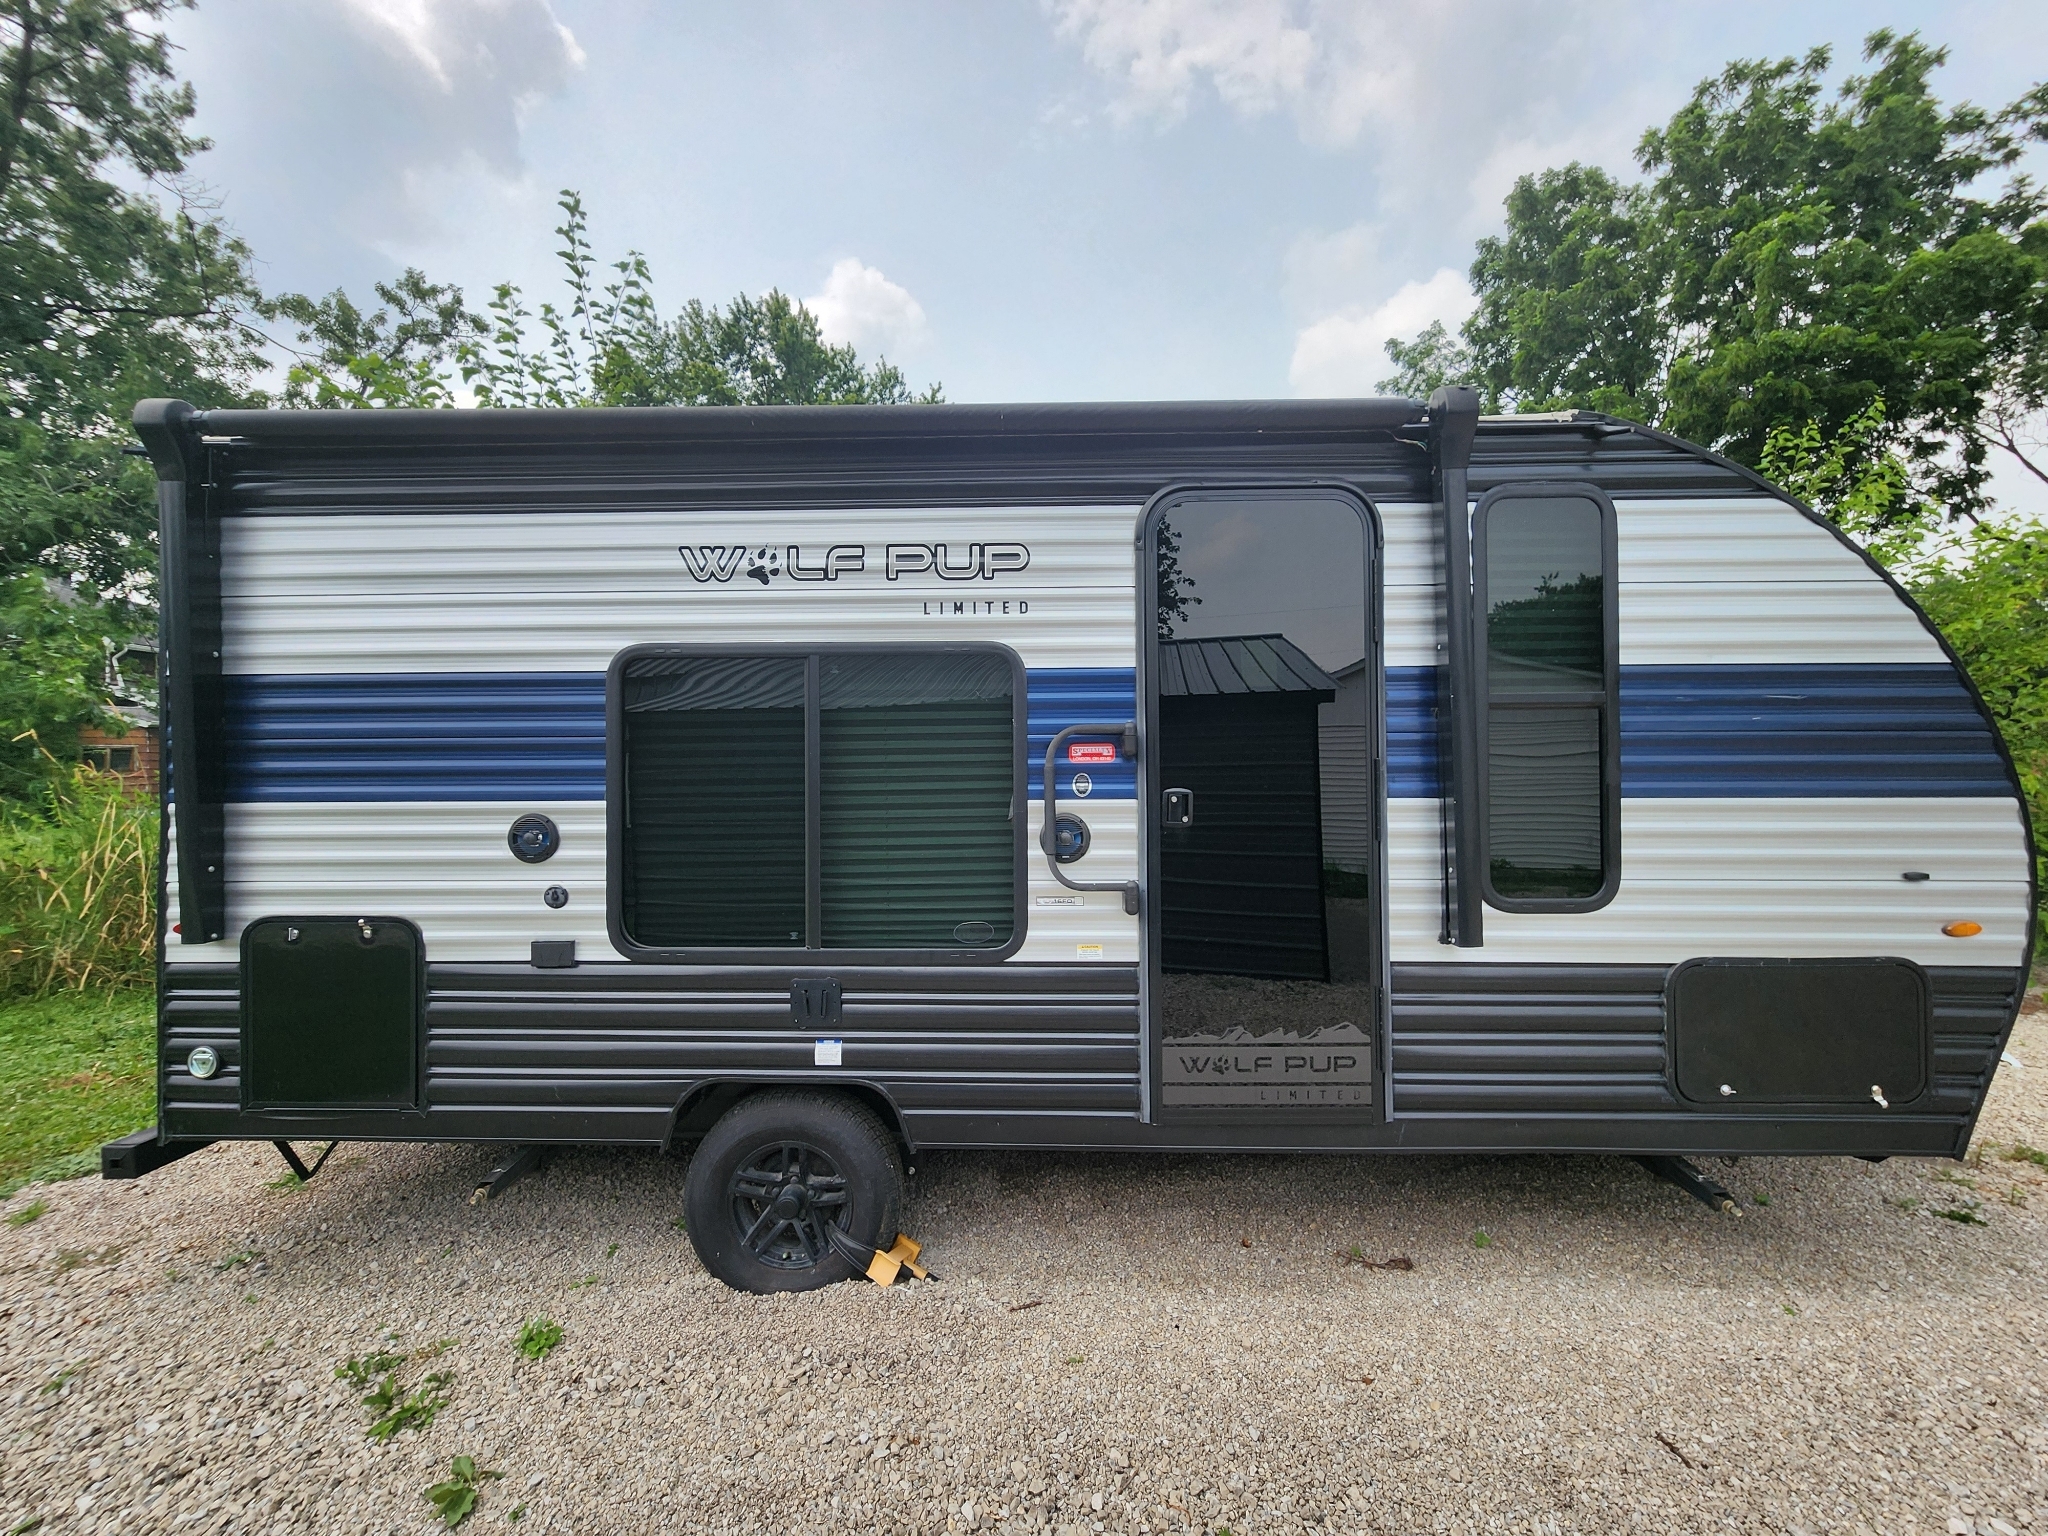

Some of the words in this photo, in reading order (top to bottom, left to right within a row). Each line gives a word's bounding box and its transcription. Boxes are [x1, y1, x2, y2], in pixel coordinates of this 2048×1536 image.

[885, 543, 1031, 582] PUP
[923, 601, 1030, 615] LIMITED
[1284, 1055, 1357, 1073] PUP
[1260, 1089, 1361, 1101] LIMITED
